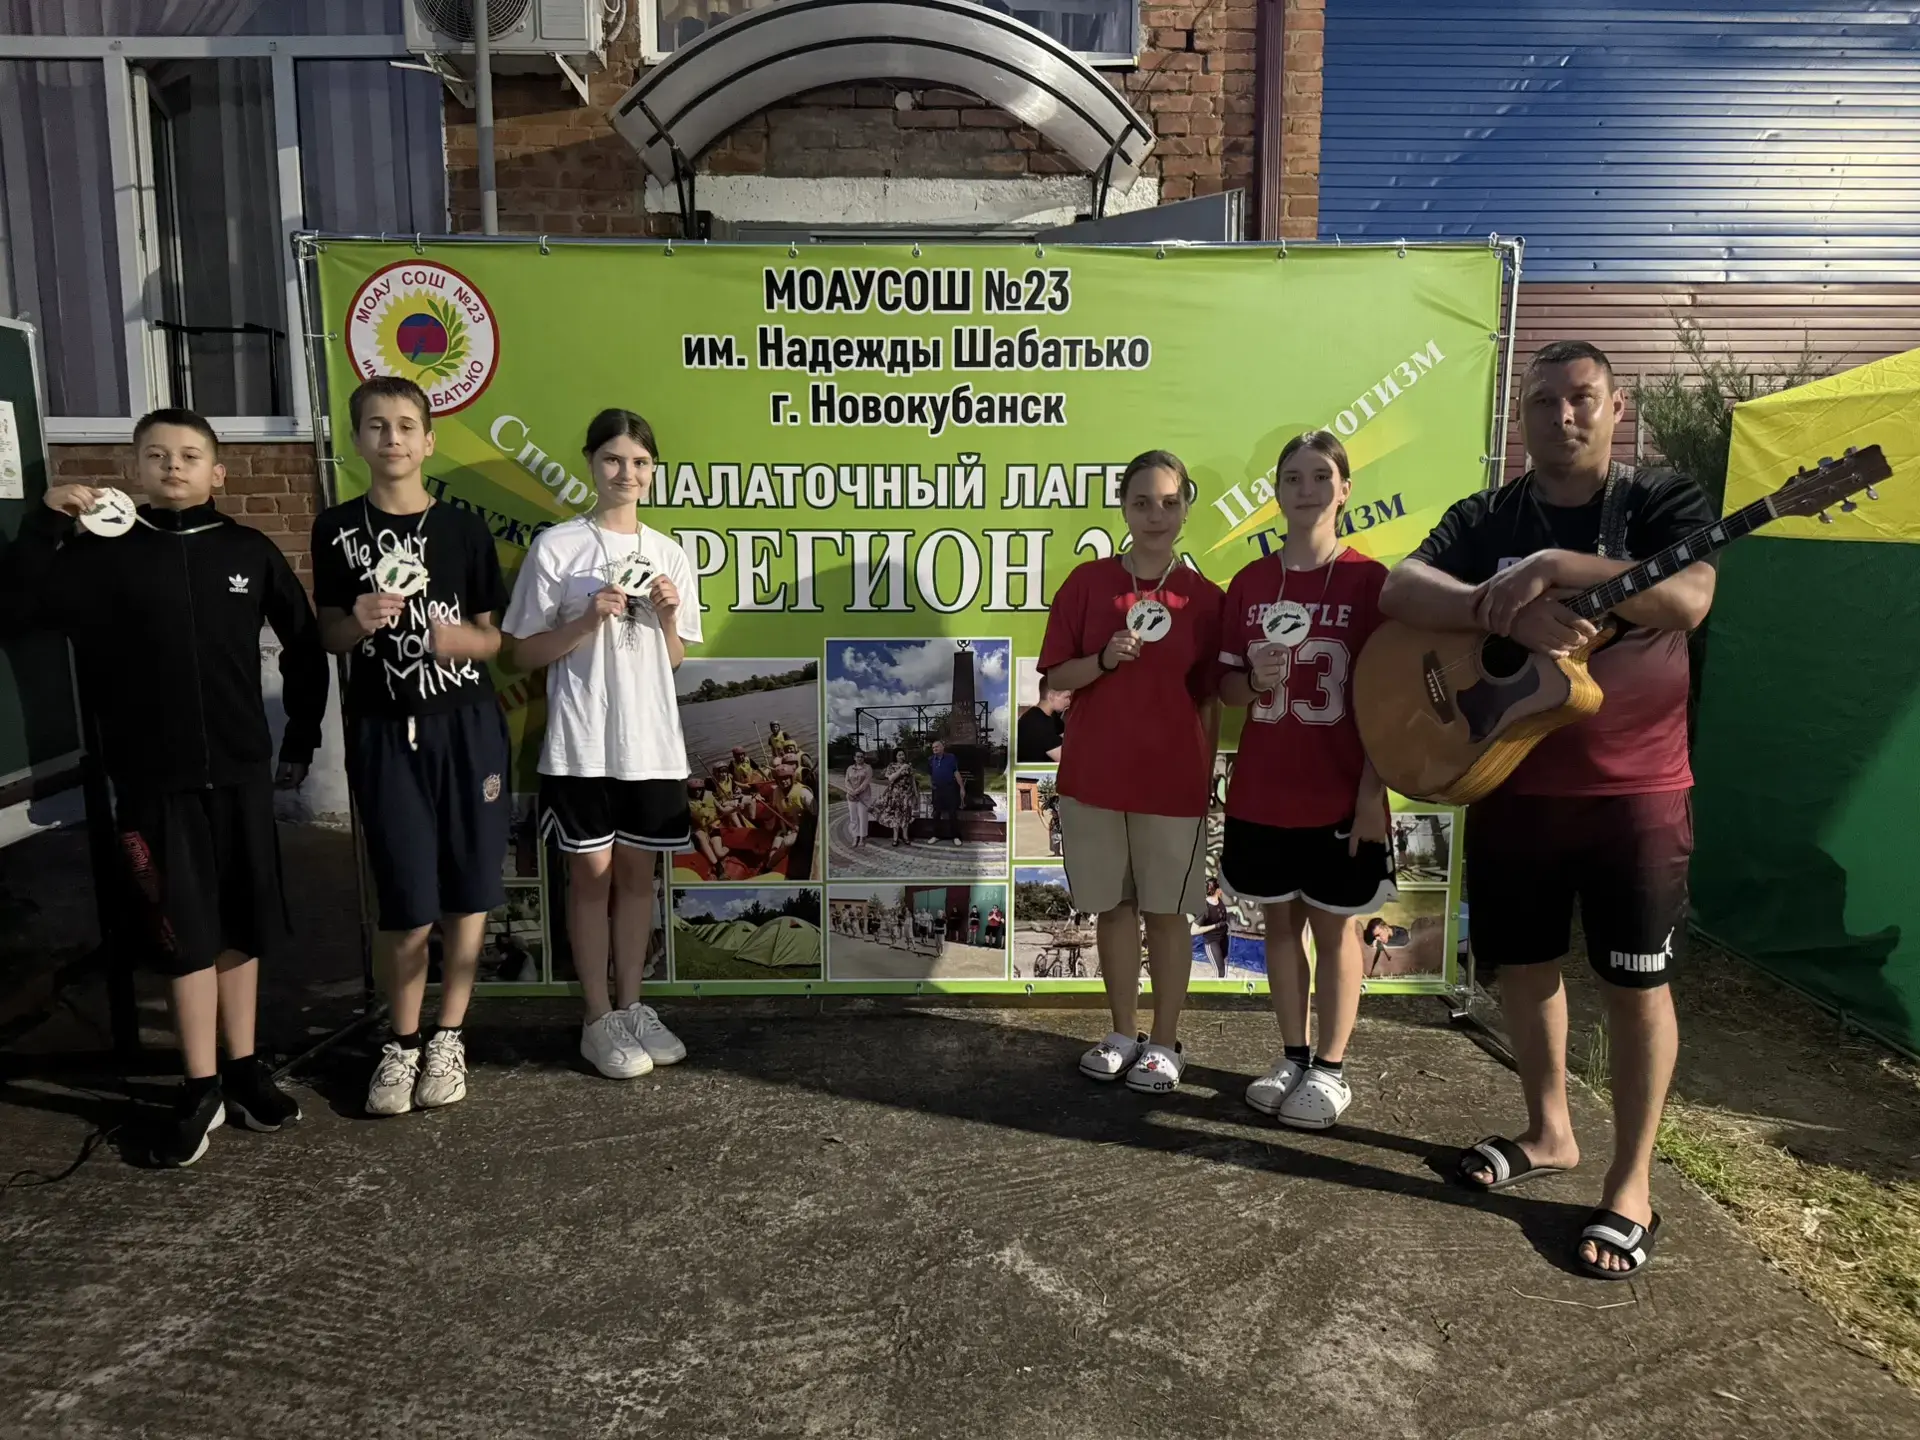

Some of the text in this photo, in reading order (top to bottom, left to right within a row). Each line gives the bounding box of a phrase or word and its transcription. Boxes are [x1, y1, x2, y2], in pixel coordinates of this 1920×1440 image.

[356, 270, 485, 324] МОАУ СОШ №23
[764, 269, 1070, 312] МОАУСОШ №23
[684, 327, 1149, 374] им. Надежды Шабатько
[772, 384, 1065, 435] г. Новокубанск
[1001, 463, 1197, 509] ЛАГЕ
[671, 527, 1053, 613] РЕГИОН
[1610, 950, 1666, 973] PUMA
